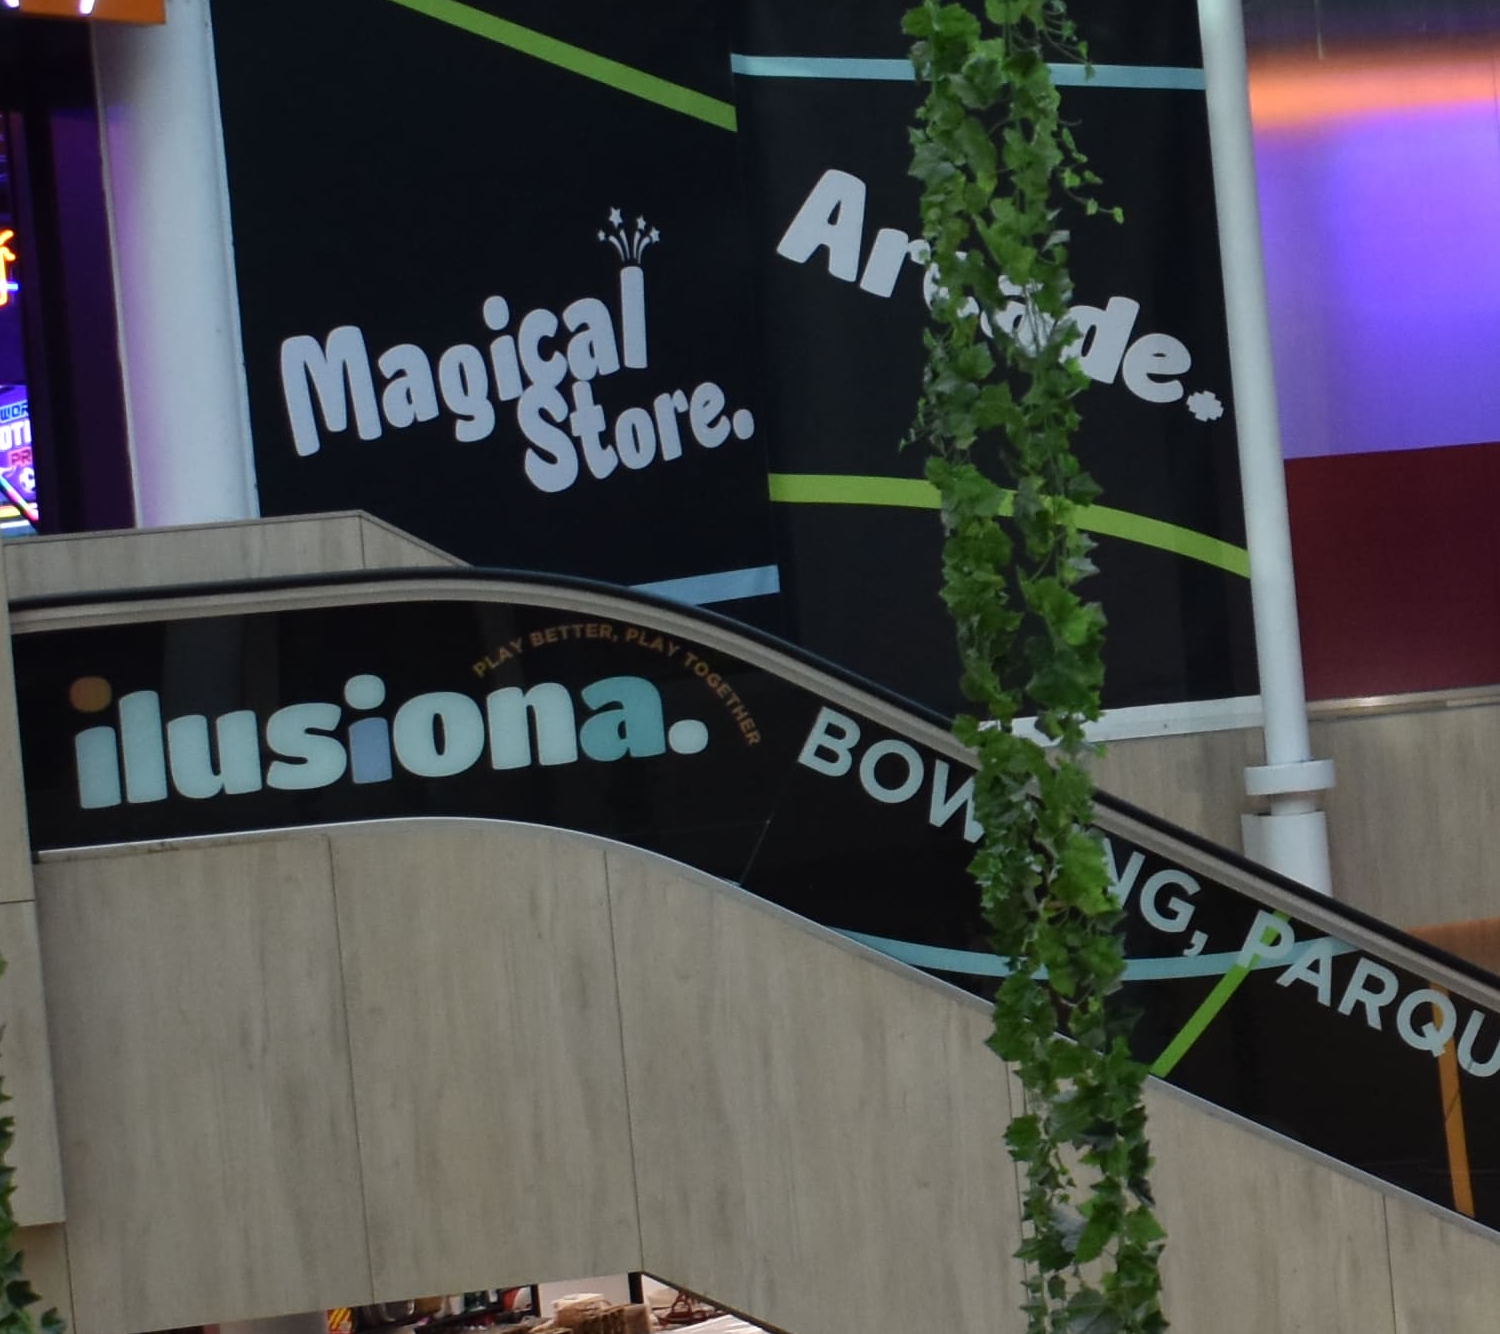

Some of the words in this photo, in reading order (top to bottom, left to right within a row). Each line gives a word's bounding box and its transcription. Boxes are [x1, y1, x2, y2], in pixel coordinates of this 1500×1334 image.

[280, 265, 648, 456] Magical
[517, 378, 755, 494] Store.
[69, 673, 709, 809] ilusiona.
[472, 637, 523, 678] PLAY
[530, 623, 618, 649] BETTER,
[625, 627, 681, 658] PLAY
[684, 651, 762, 747] TOGETHER
[797, 706, 1210, 957] BOWNG,
